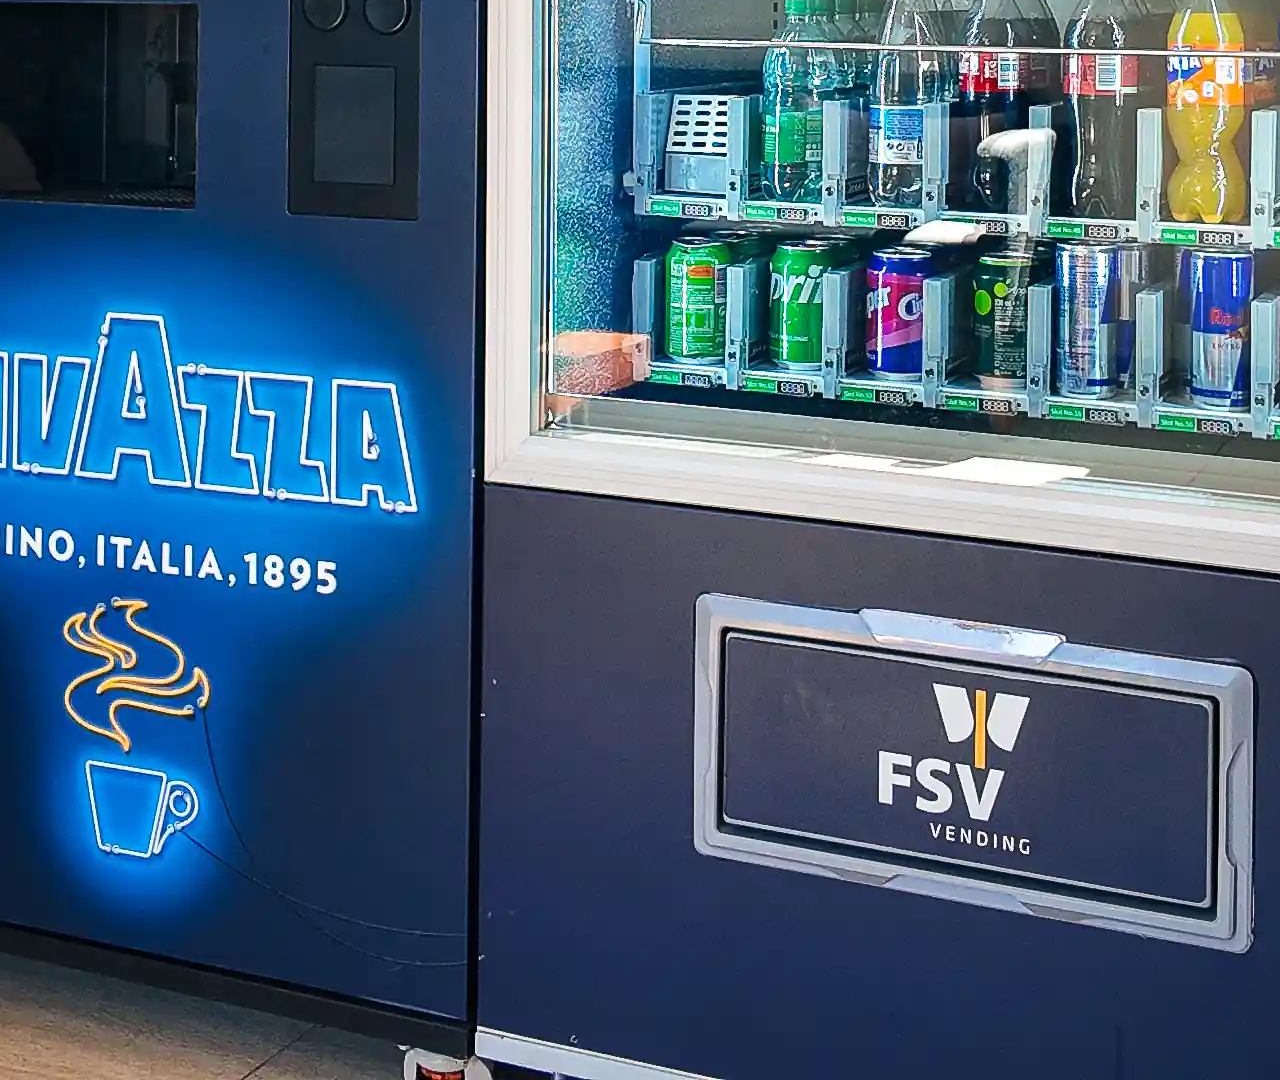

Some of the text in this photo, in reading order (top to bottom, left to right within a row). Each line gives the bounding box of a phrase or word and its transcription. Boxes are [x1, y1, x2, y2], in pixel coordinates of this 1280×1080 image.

[96, 534, 236, 586] ITALIA,
[244, 552, 338, 594] 1895
[878, 750, 1005, 821] FSV
[930, 822, 1031, 854] VENDING
